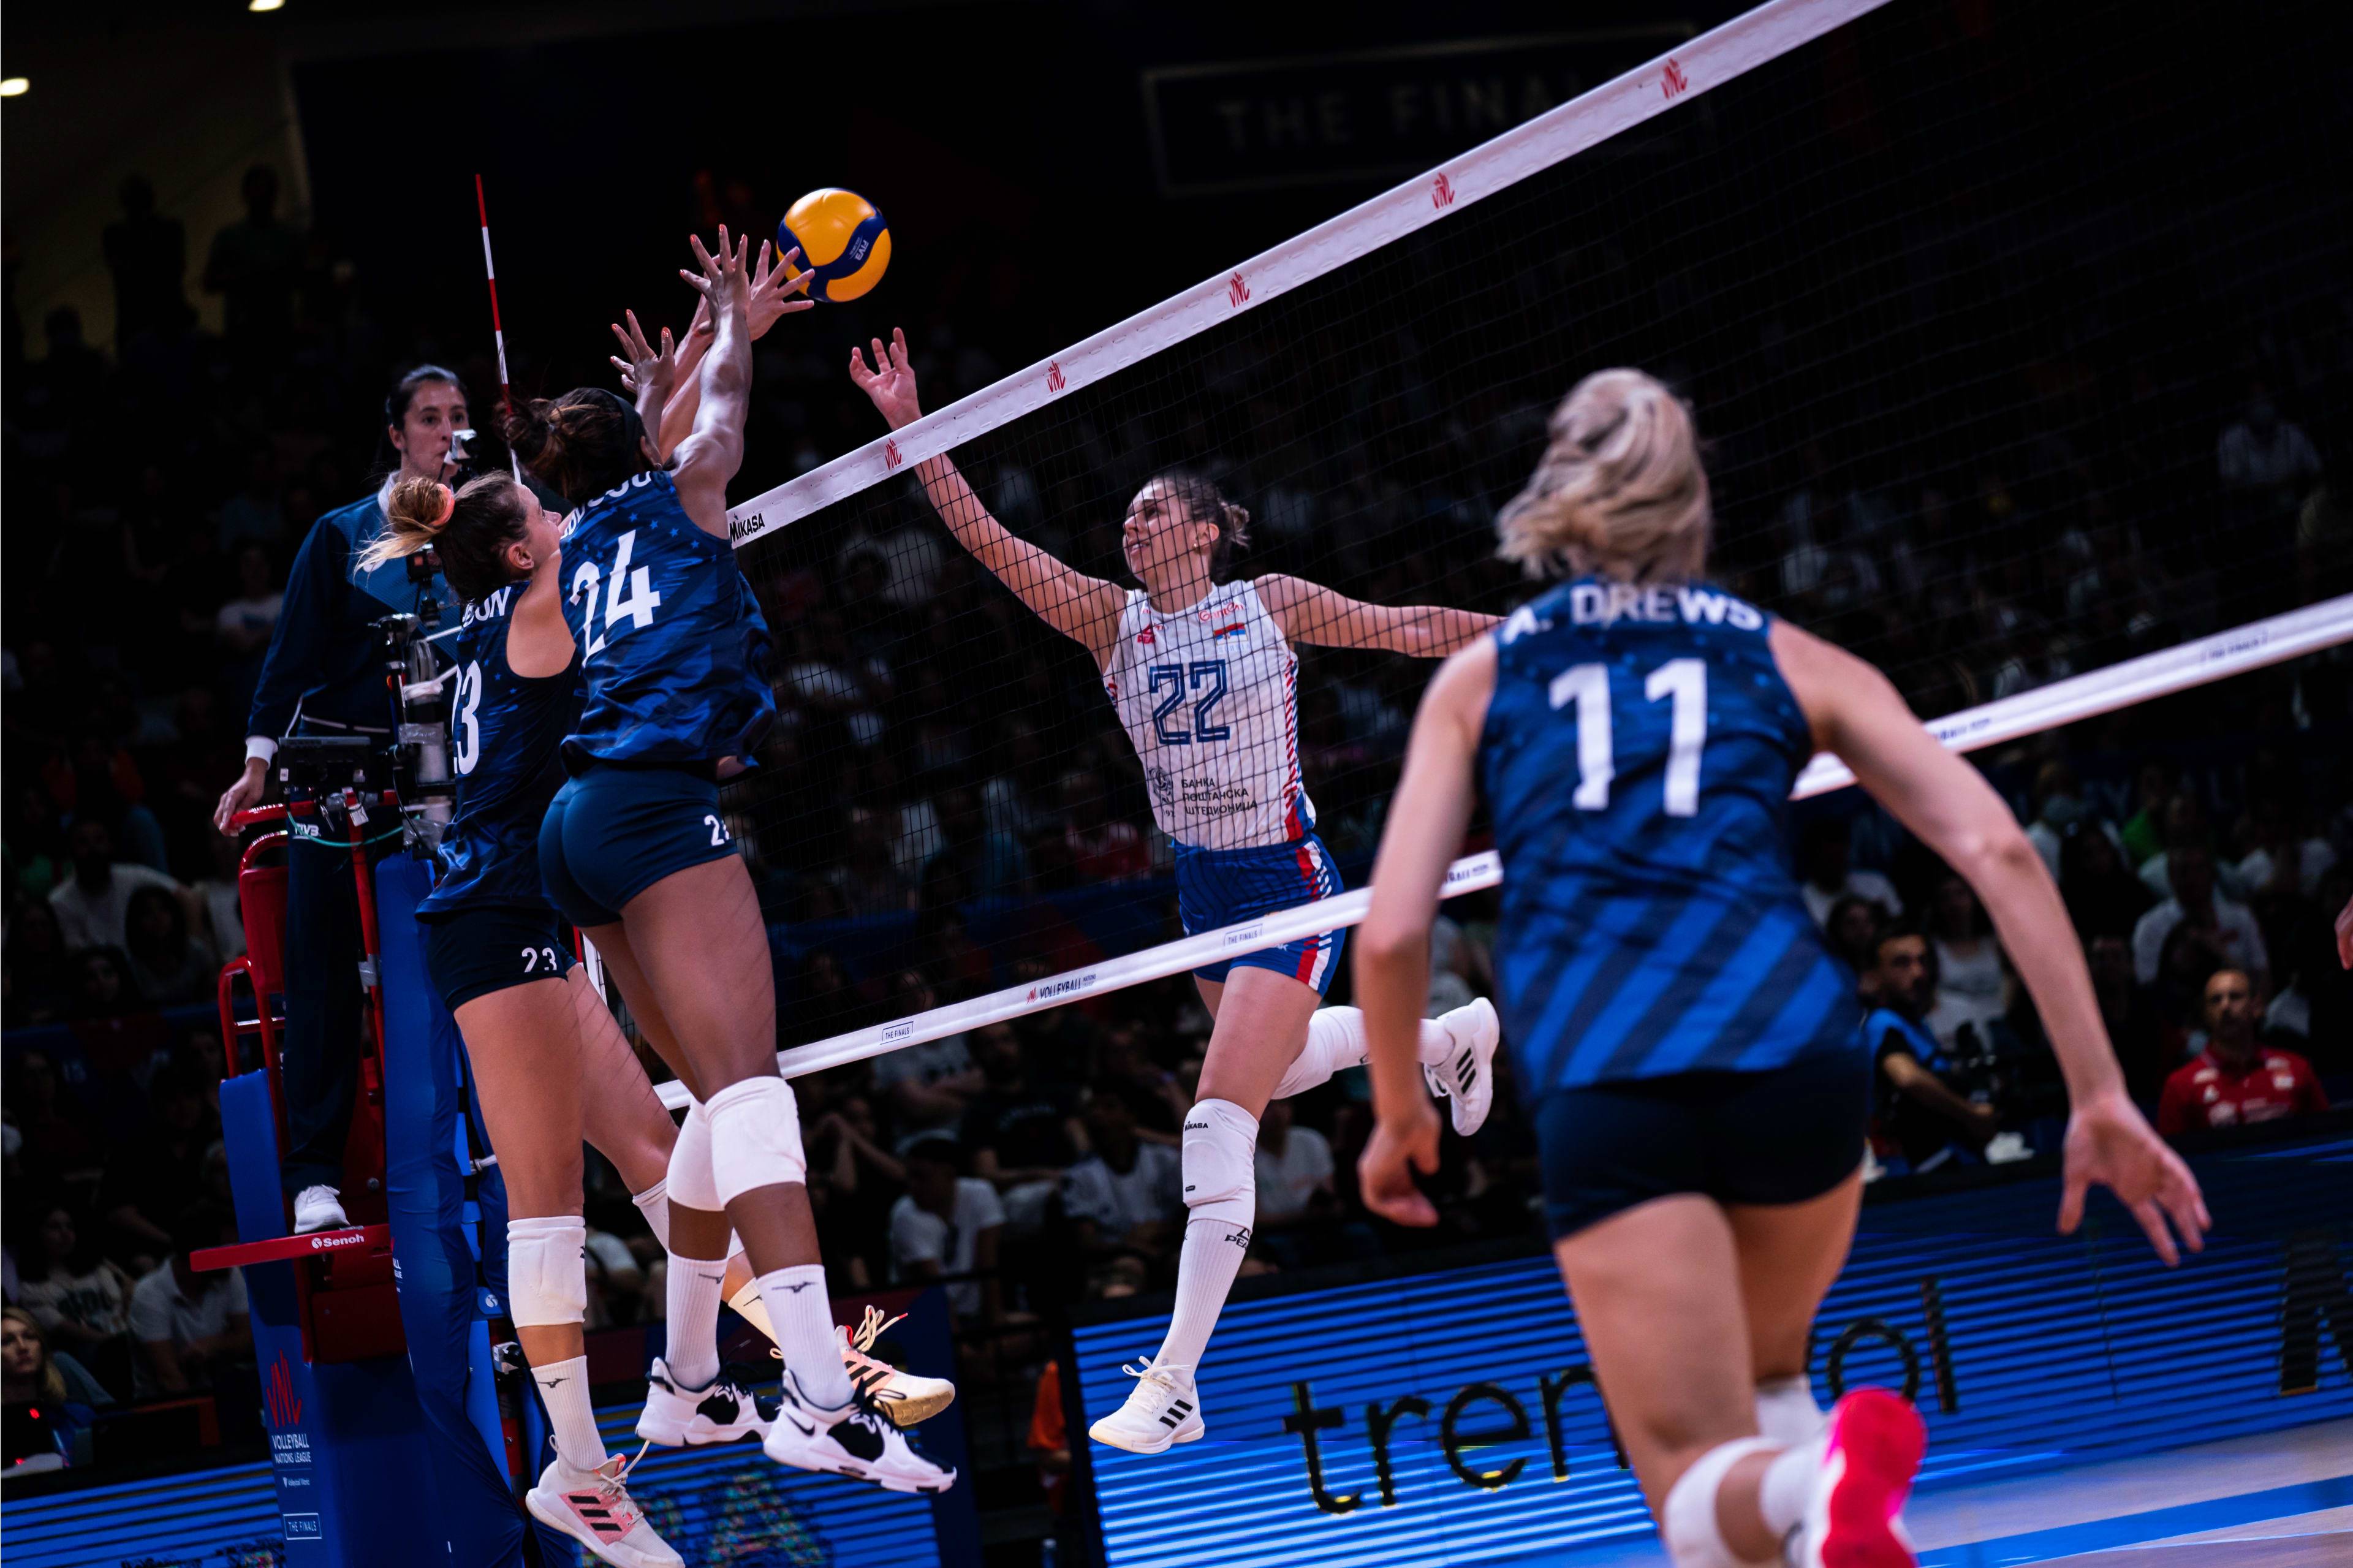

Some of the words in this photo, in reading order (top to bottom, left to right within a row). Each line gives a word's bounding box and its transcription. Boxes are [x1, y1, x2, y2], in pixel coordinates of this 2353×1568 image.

[1211, 88, 1354, 154] THE
[729, 513, 765, 542] MIKASA
[569, 529, 661, 669] 24
[1569, 583, 1764, 632] DREWS
[1149, 659, 1230, 745] 22
[1548, 657, 1708, 819] 11
[1181, 778, 1216, 788] БАНКА
[1183, 788, 1249, 801] ПОШТАНСКА
[521, 947, 558, 973] 23
[1040, 978, 1081, 999] VOLLEYBALL
[895, 1027, 909, 1037] FINALS
[322, 1233, 365, 1248] Senoh
[1283, 1275, 1957, 1513] trenol
[271, 1433, 309, 1450] VOLLEYBALL
[275, 1453, 294, 1464] NATIONS
[295, 1452, 312, 1463] LEAGUE
[288, 1521, 298, 1532] THE
[298, 1520, 317, 1531] FINALS
